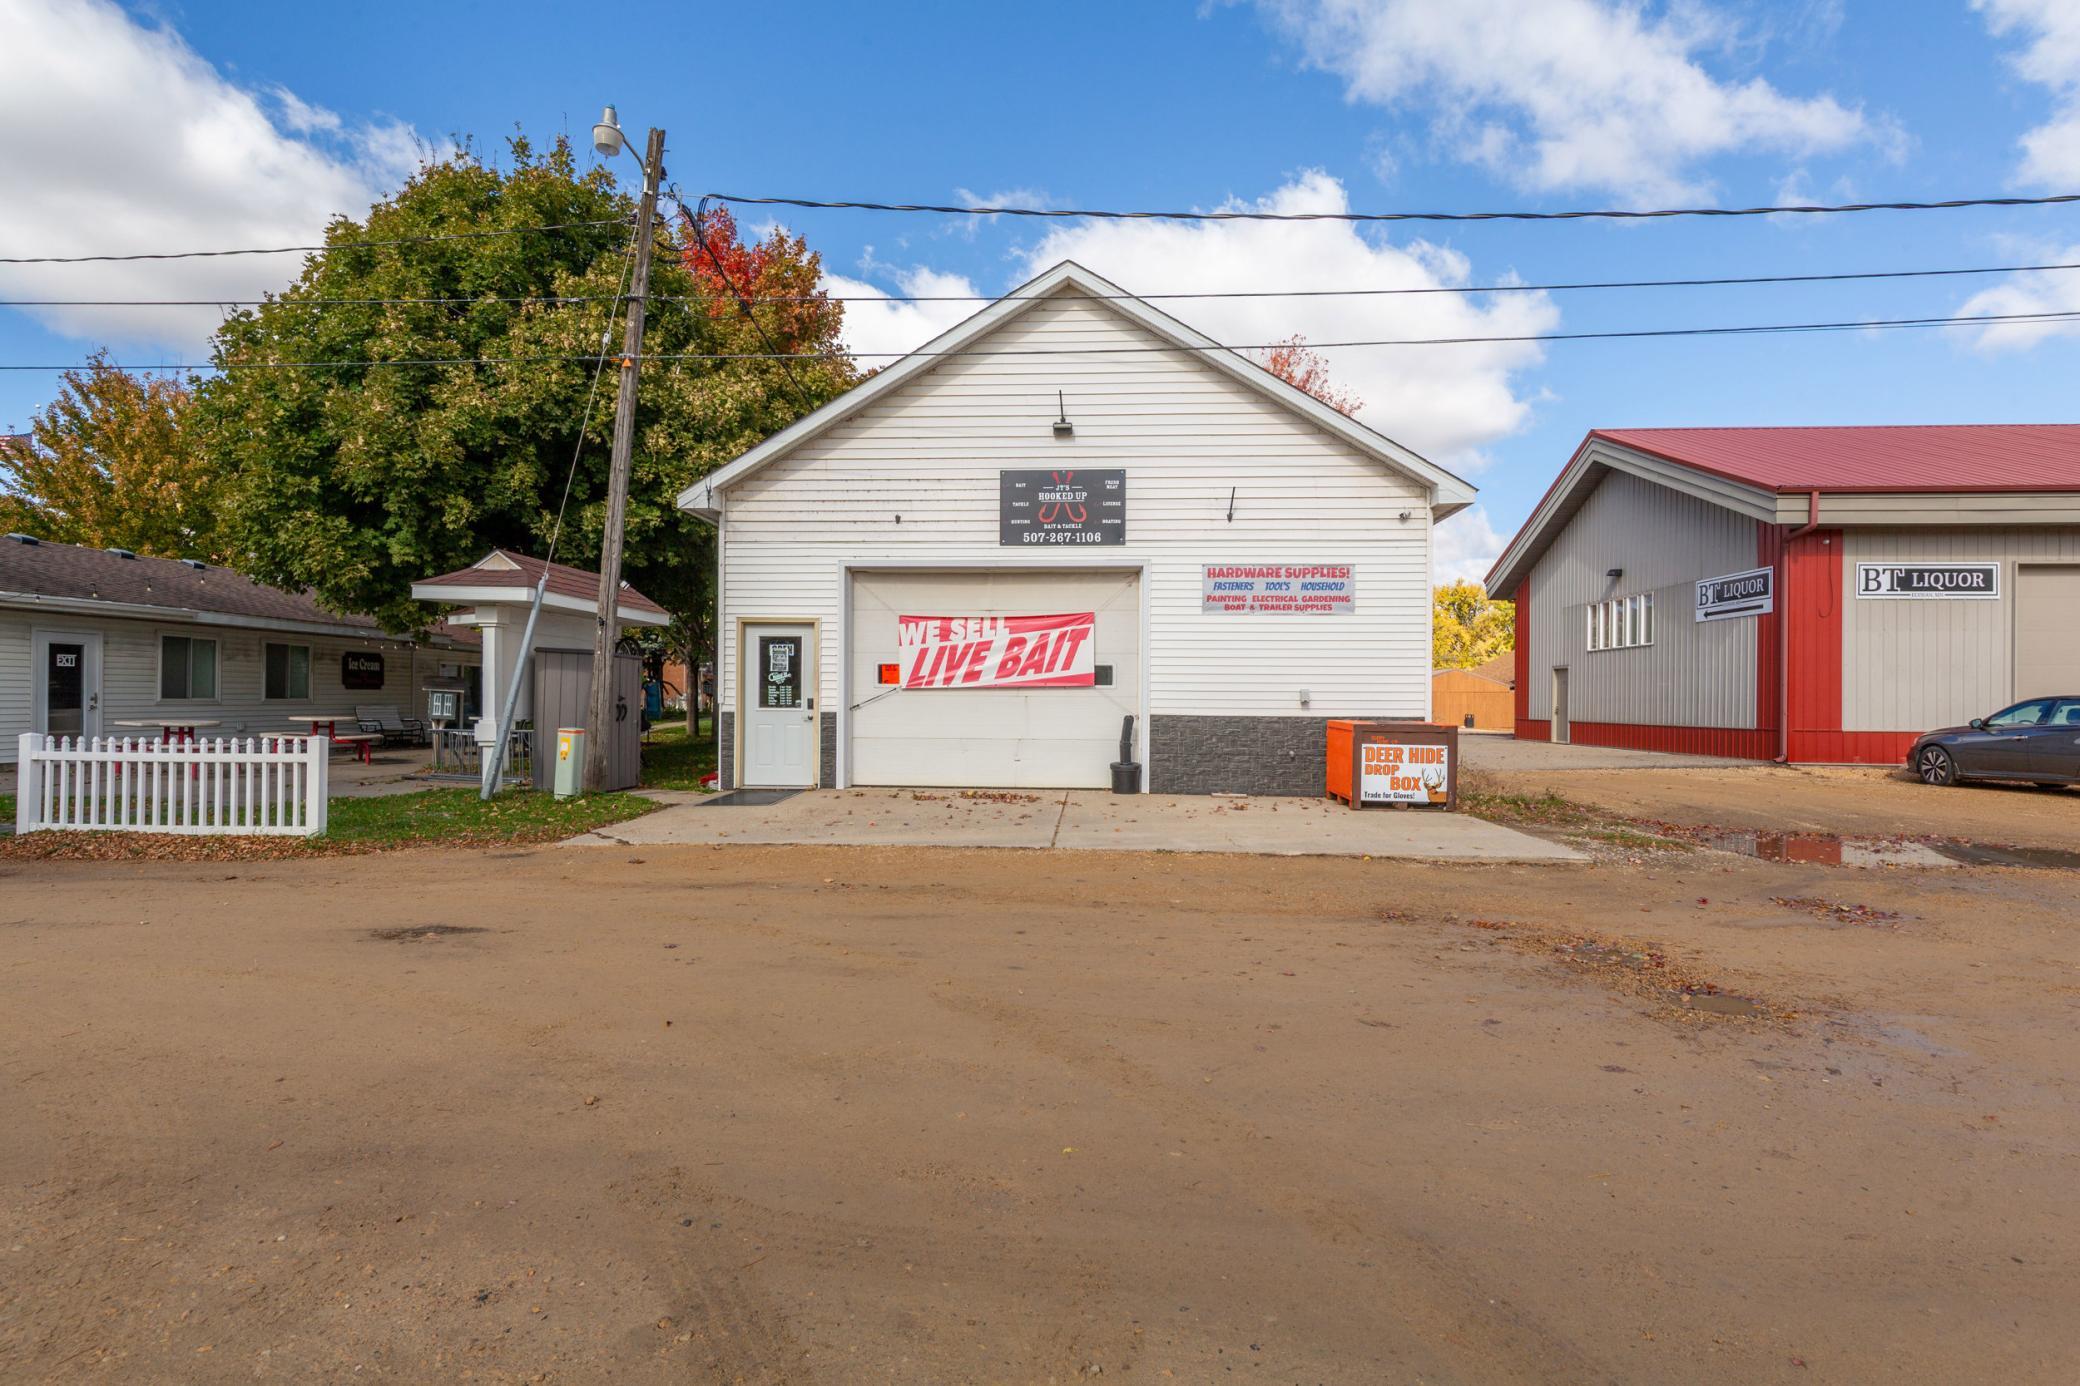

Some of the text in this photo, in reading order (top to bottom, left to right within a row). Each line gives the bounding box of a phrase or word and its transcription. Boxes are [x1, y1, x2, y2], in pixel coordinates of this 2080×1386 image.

[1038, 491, 1088, 501] HOOKED UP
[1023, 532, 1101, 543] 507-267-1106
[1207, 567, 1350, 579] HARDWARE SUPPLIES!
[1213, 581, 1345, 591] FASTENERS TOOL'S HOUSEHOLD
[1862, 568, 1985, 592] BT LIQUOR
[1699, 578, 1764, 606] BT LIQUOR
[1206, 595, 1351, 603] PAINTING ELECTRICAL GARDENING
[899, 616, 1010, 647] WE SELL
[56, 654, 77, 666] EXIT
[906, 627, 1092, 688] LIVE BAIT
[348, 657, 380, 671] Ice Cream
[1364, 746, 1445, 764] DEER HIDE
[1364, 764, 1400, 775] DROP
[1390, 776, 1421, 791] BOX
[1364, 791, 1381, 799] Trade
[1383, 791, 1391, 799] for
